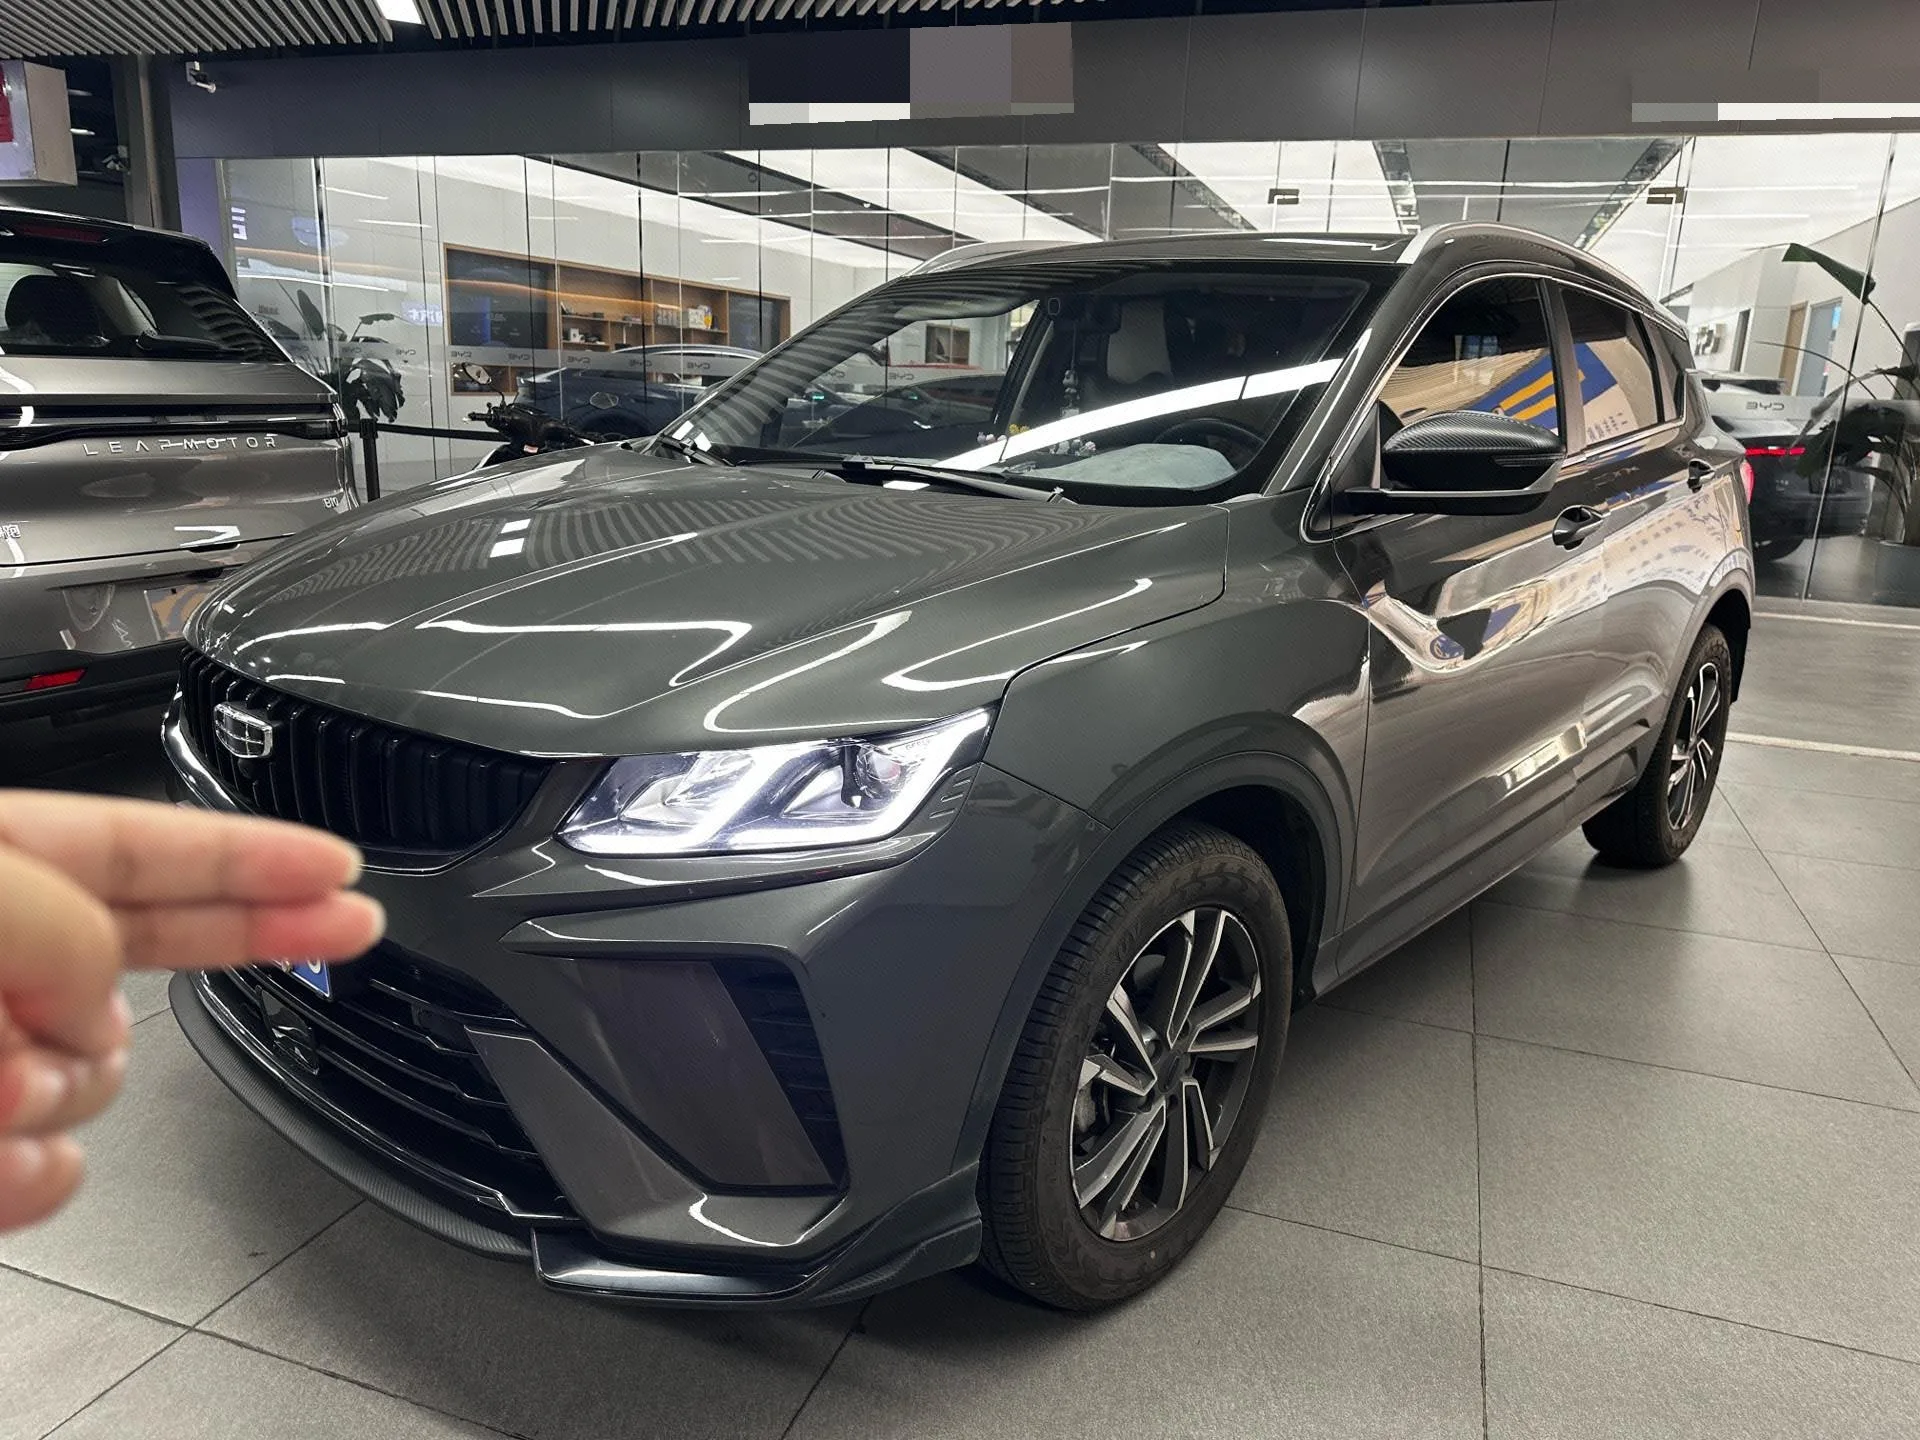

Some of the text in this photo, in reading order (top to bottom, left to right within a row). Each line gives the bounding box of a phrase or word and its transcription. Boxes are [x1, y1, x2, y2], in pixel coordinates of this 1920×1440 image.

[450, 350, 473, 358] BYD
[507, 353, 531, 361] BYD
[567, 355, 591, 364] BYD
[686, 361, 711, 370] BYD
[888, 372, 915, 381] BYD
[1746, 400, 1785, 411] BYD
[82, 433, 279, 456] LEAPMOTOR
[323, 496, 340, 509] B10
[0, 524, 21, 539] 跑
